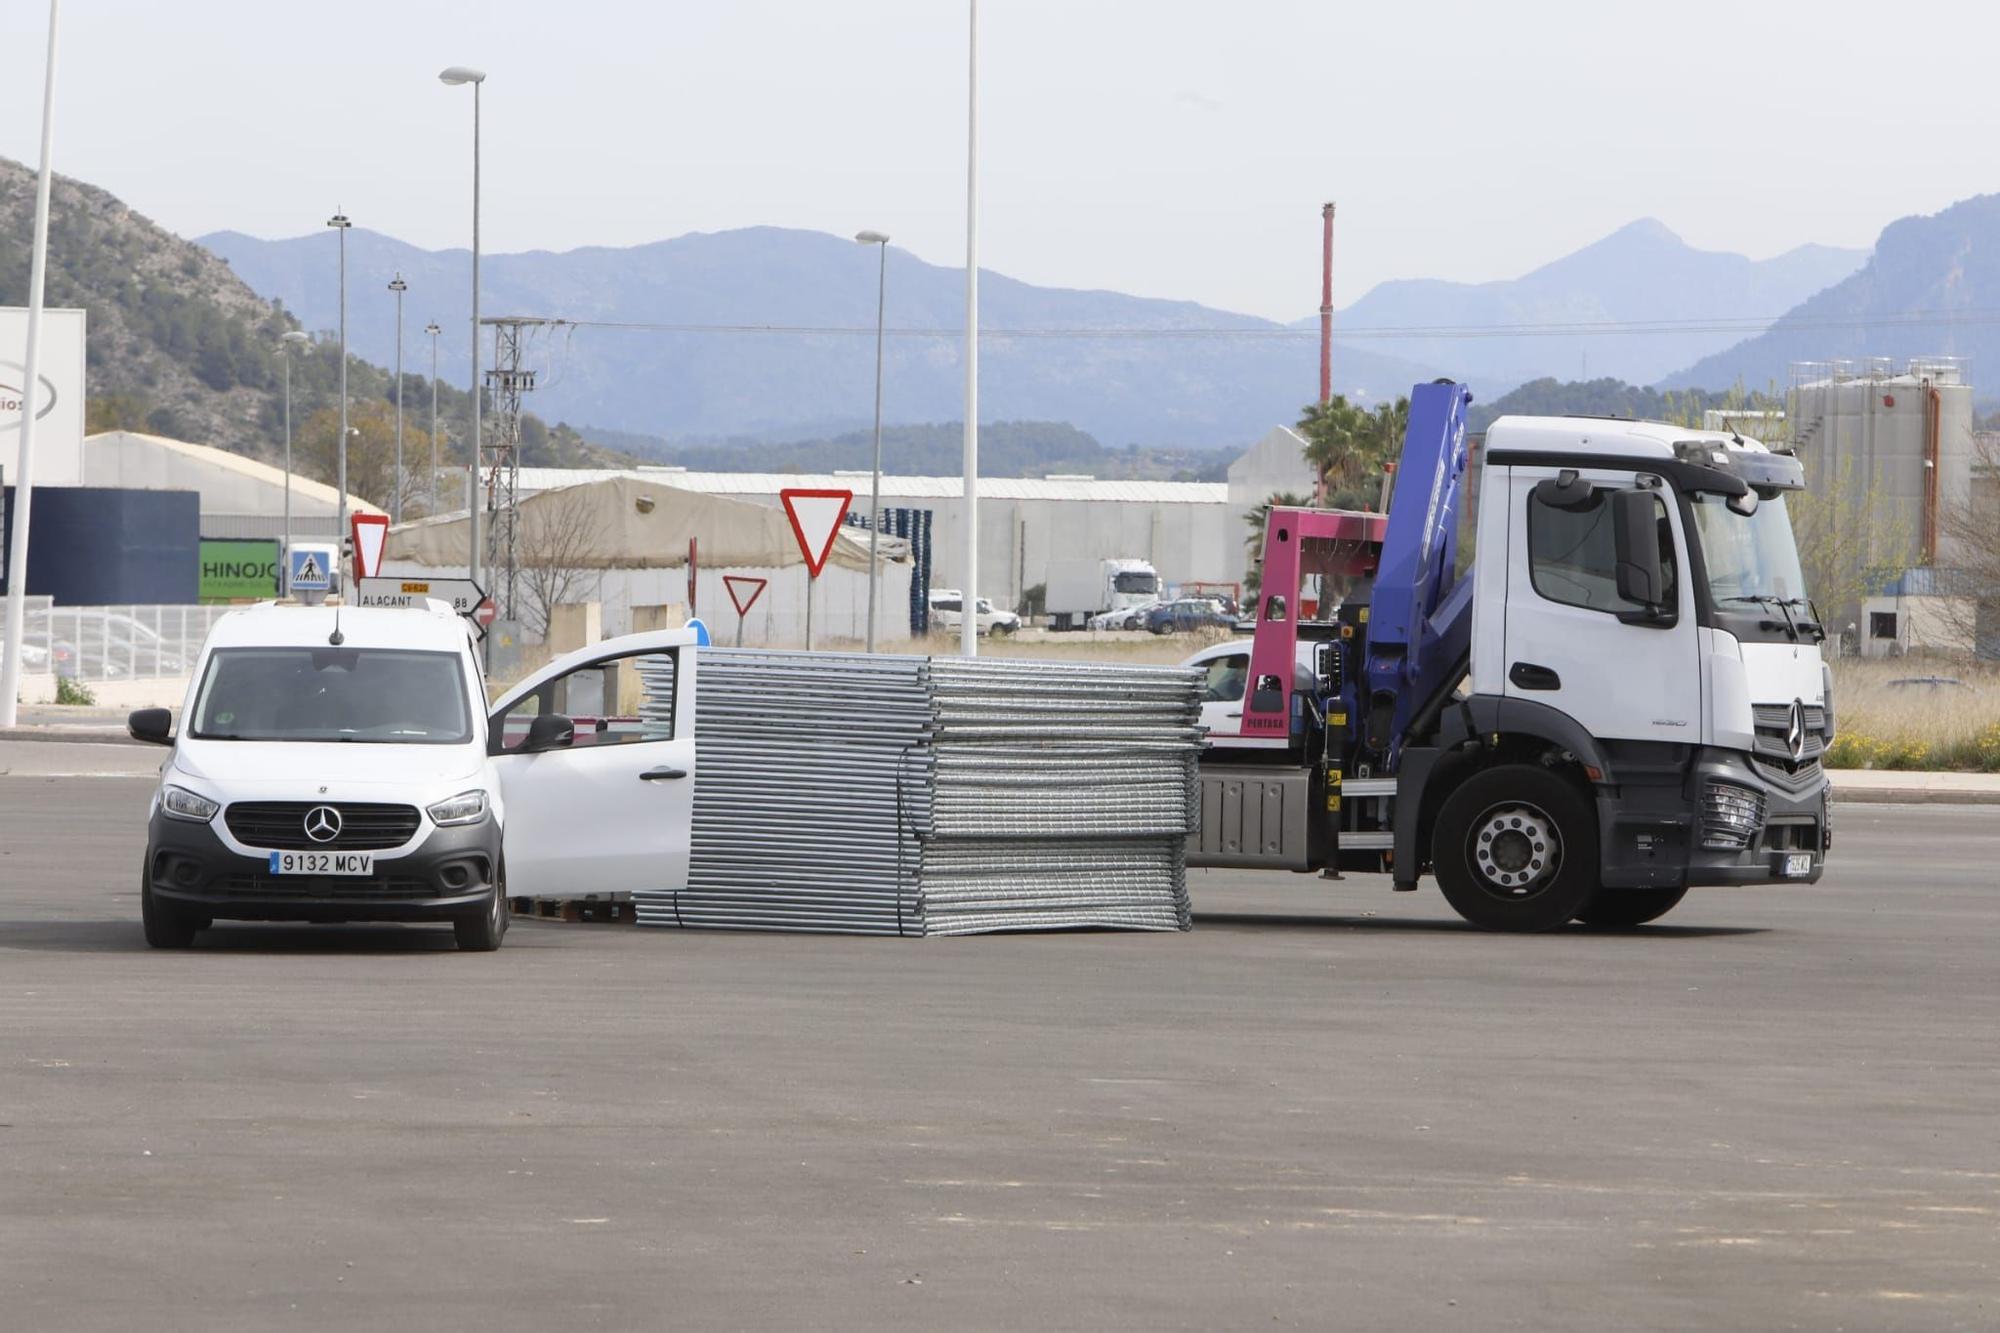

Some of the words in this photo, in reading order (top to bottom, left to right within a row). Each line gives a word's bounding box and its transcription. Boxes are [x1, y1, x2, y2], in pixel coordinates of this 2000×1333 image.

[362, 595, 412, 607] ALACANT
[283, 854, 329, 872] 9132
[335, 855, 370, 873] MCV
